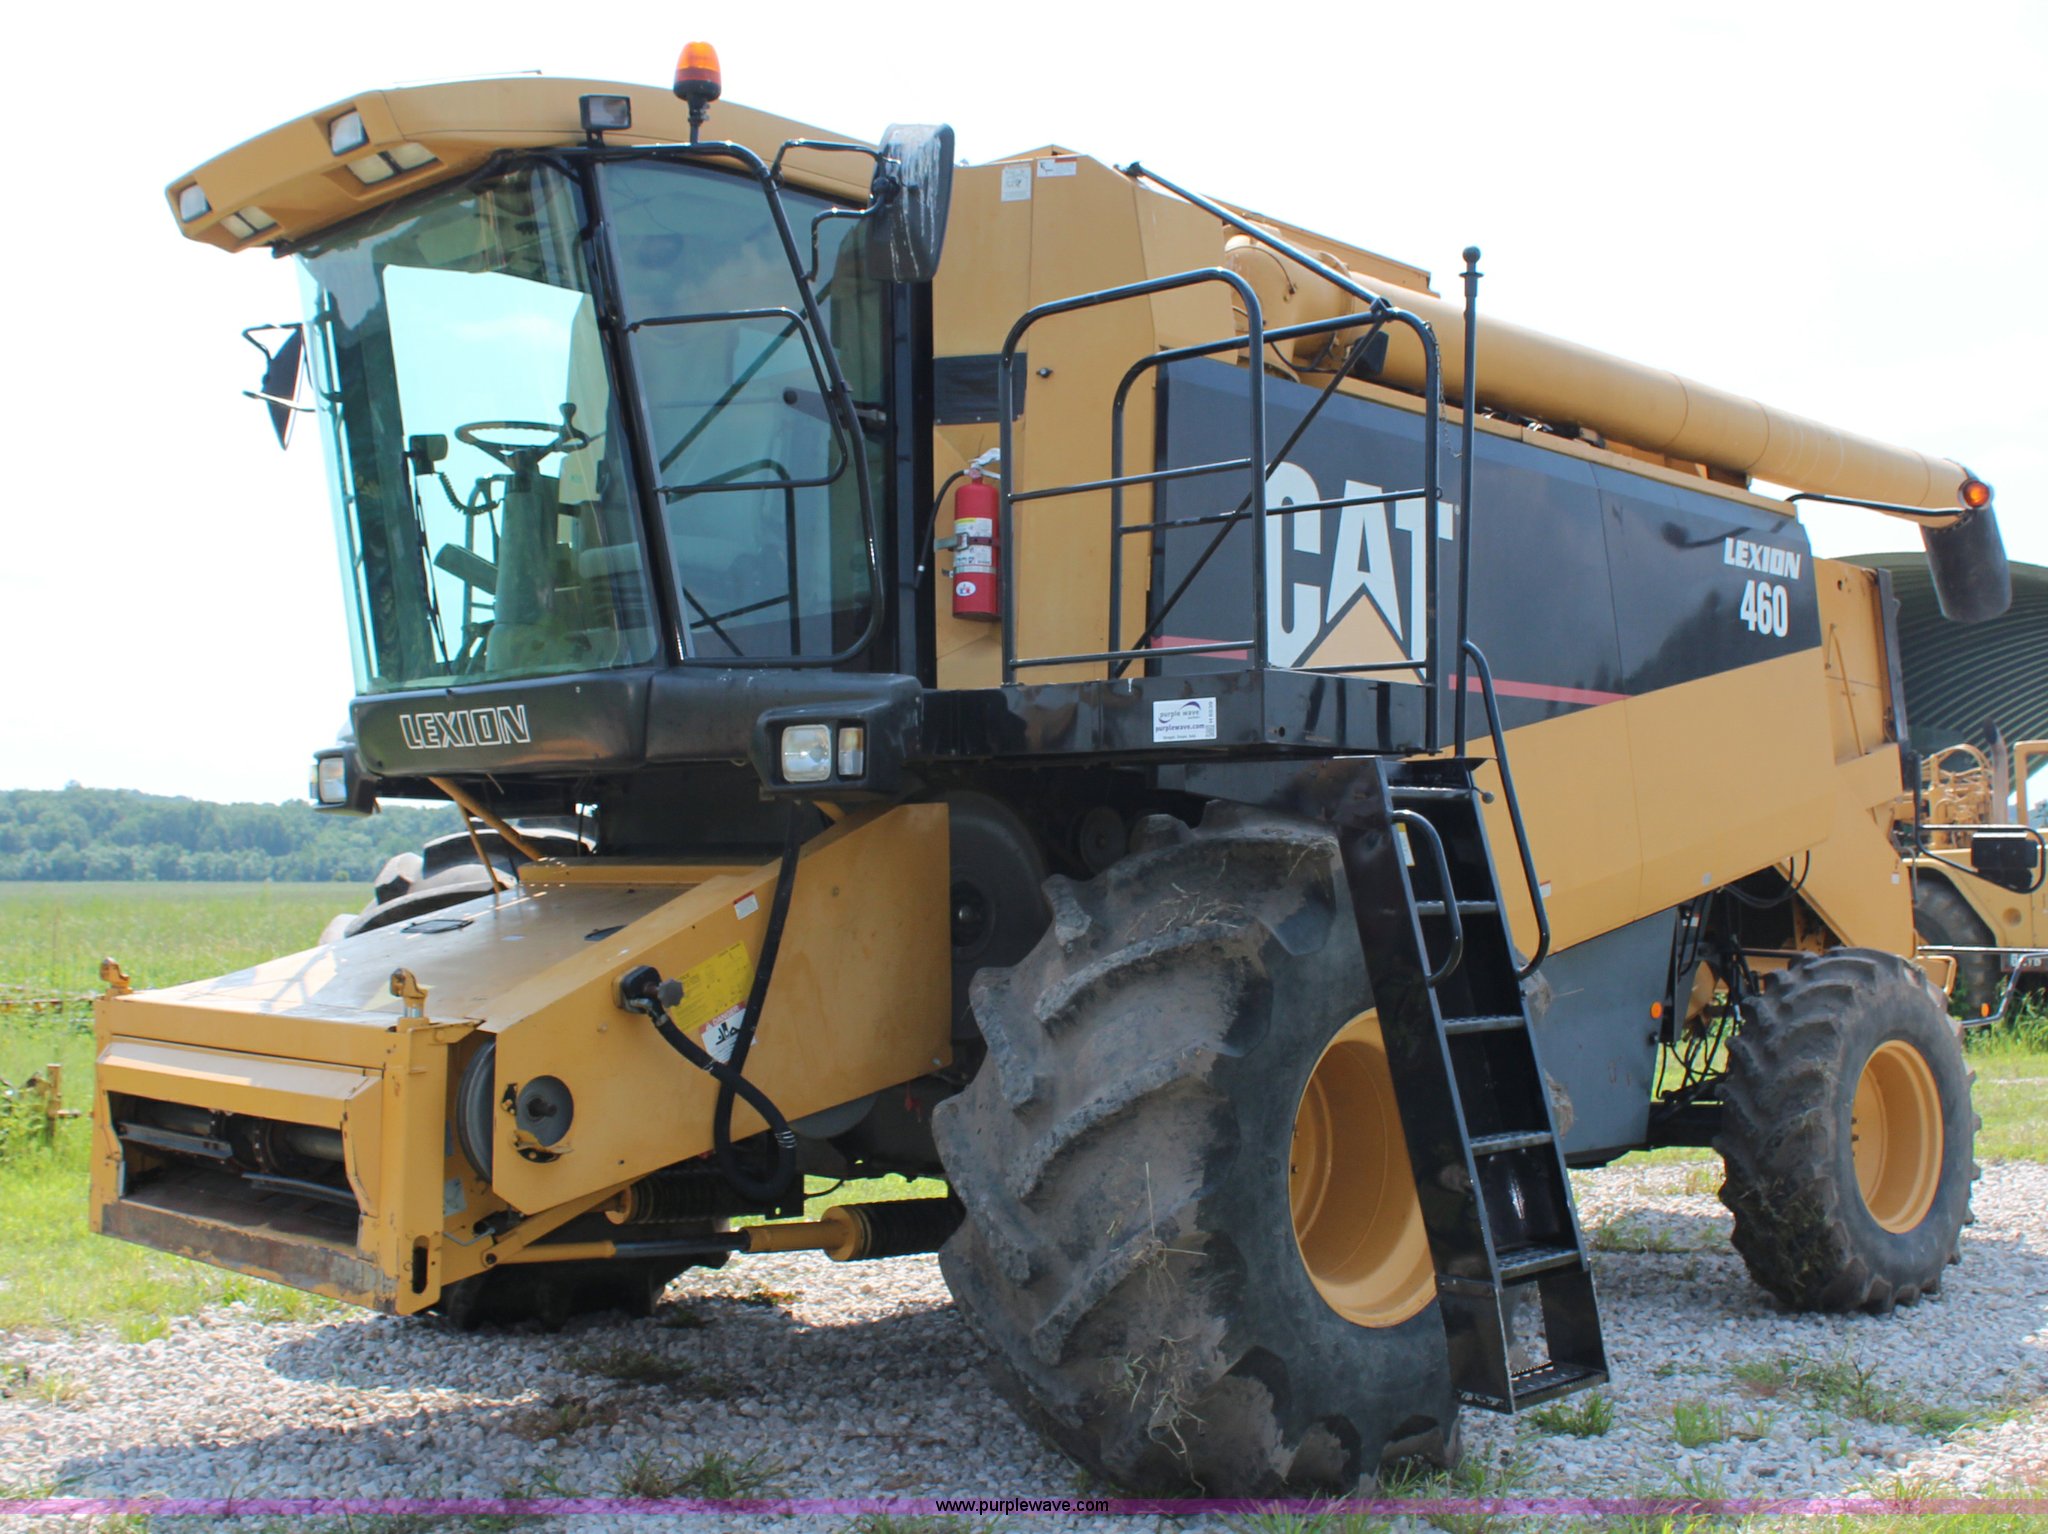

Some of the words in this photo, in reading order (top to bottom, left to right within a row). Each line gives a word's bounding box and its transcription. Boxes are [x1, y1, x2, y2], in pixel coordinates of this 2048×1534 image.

[1263, 461, 1454, 680] CAT
[1723, 536, 1801, 580] LEXION
[1740, 579, 1788, 638] 460
[399, 704, 531, 750] LEXION
[1155, 724, 1205, 732] purplewave.com
[1159, 710, 1181, 718] purple
